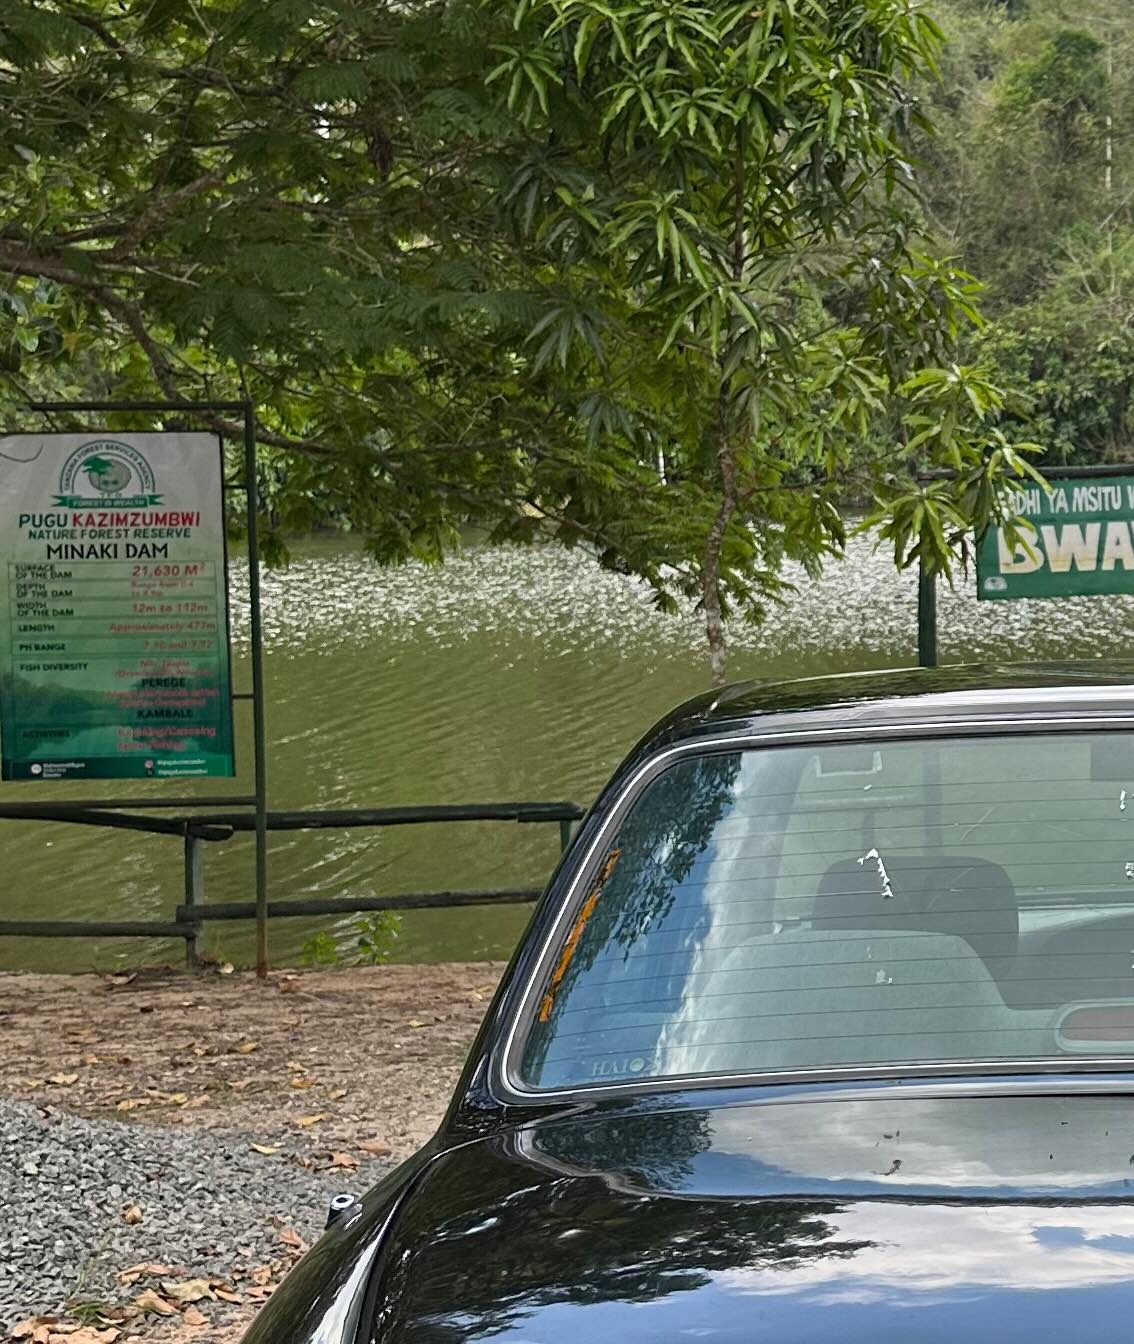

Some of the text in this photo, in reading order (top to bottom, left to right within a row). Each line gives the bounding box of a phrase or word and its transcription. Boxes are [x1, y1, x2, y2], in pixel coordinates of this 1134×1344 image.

[1046, 487, 1069, 514] YA
[1072, 485, 1122, 513] MSITU
[18, 511, 201, 529] PUGU KAZIMZUMBWI
[28, 527, 192, 540] NATURE FOREST RESERVE
[47, 542, 169, 560] MINAKI DAM
[16, 571, 73, 579] OF THE DAM
[16, 590, 28, 598] OF
[32, 590, 48, 598] THE
[17, 601, 47, 609] WIDTH
[17, 609, 74, 617] OF THE DAM
[18, 624, 55, 632] LENGTH
[19, 643, 32, 651] PH
[20, 662, 89, 672] FISH DIVERSITY
[137, 708, 194, 719] KAMBALE
